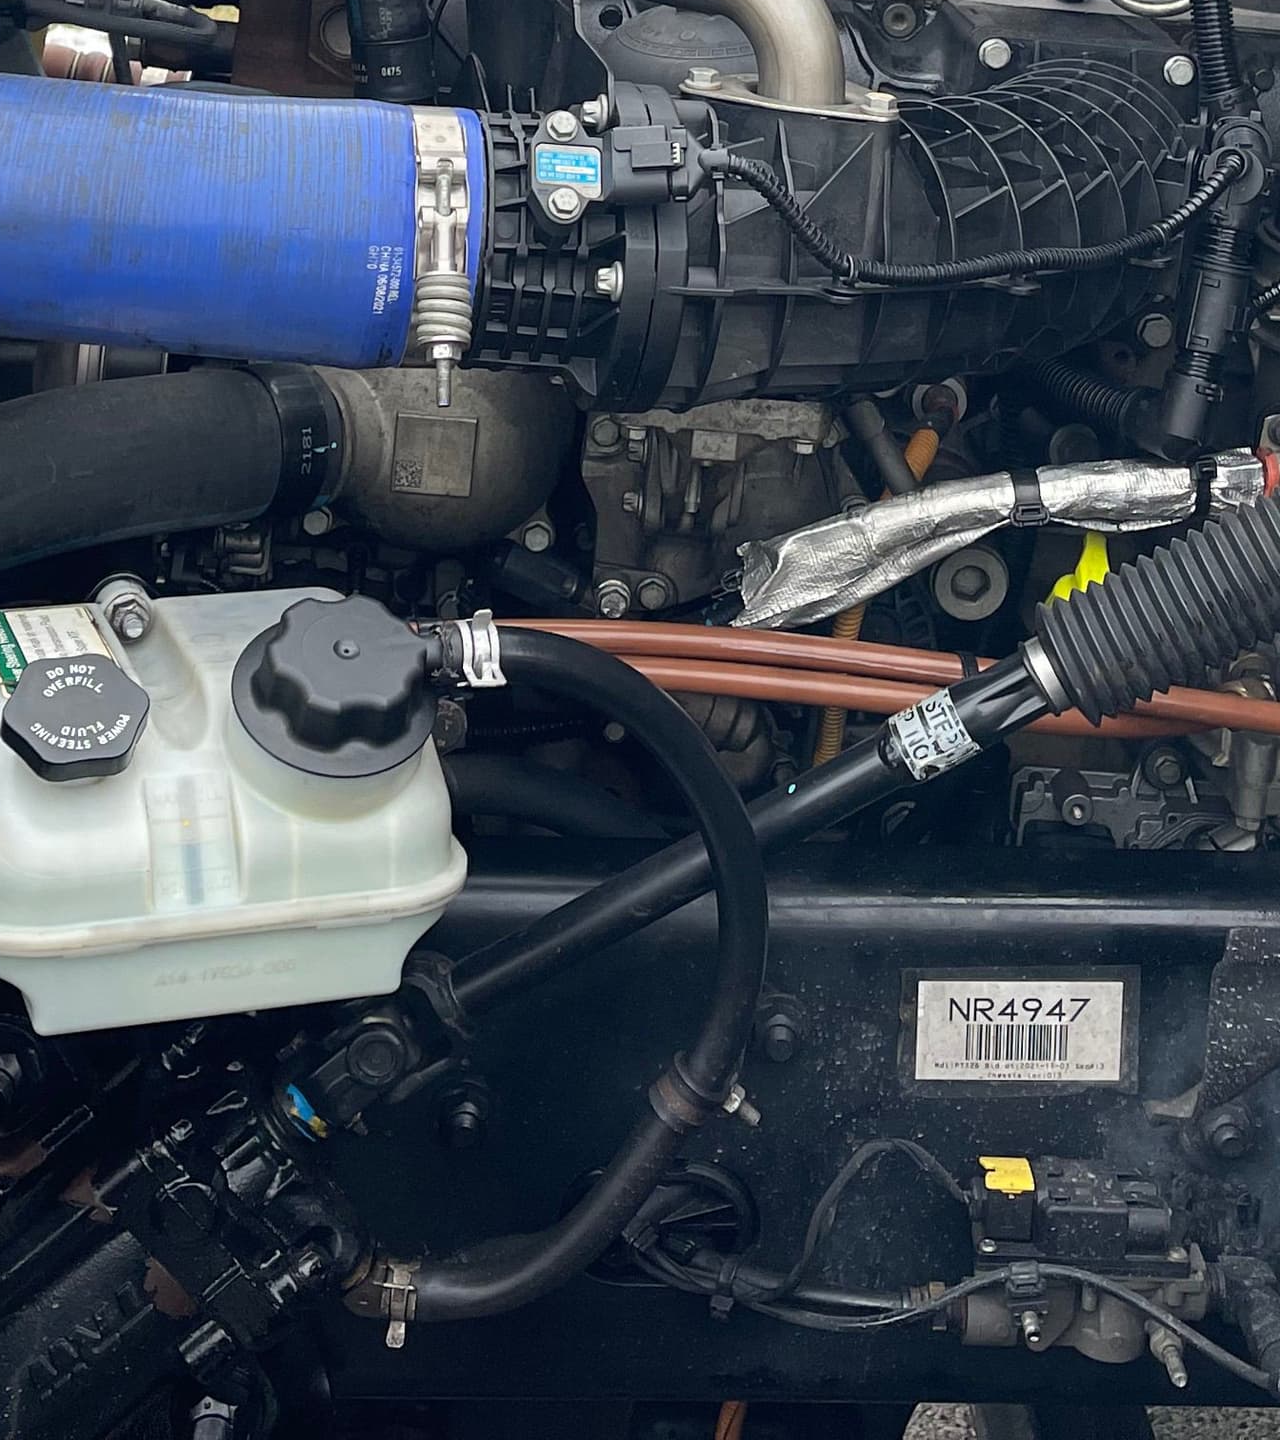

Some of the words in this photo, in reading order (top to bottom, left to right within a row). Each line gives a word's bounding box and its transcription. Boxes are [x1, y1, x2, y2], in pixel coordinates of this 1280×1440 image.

[300, 426, 313, 476] 2181
[46, 666, 65, 681] DO
[69, 664, 96, 675] NOT
[42, 675, 104, 698] OVERFILL
[30, 722, 91, 750] STEERING
[61, 721, 105, 737] FLUID
[97, 714, 131, 745] POWER
[949, 997, 1092, 1022] NR4947
